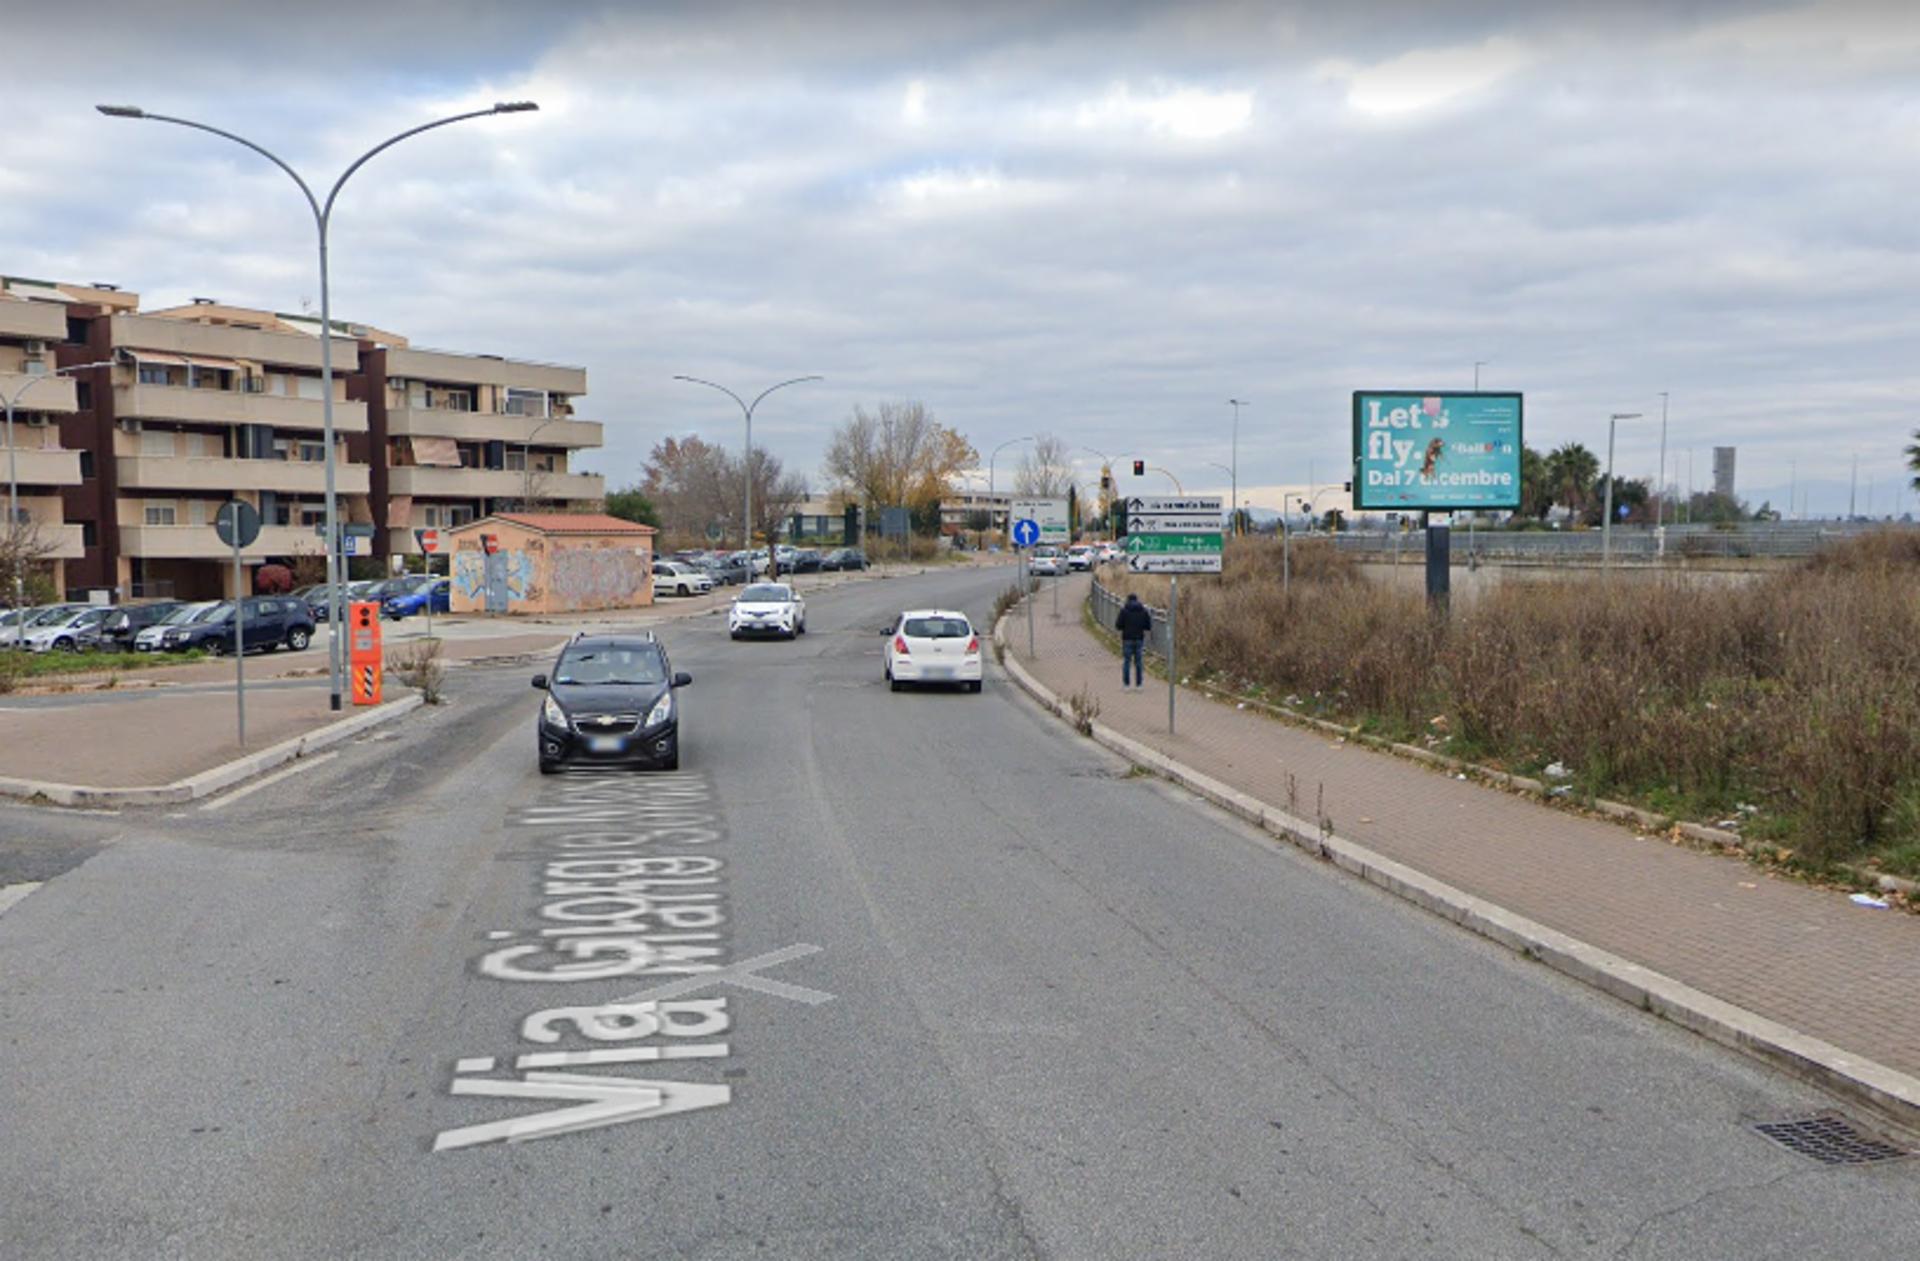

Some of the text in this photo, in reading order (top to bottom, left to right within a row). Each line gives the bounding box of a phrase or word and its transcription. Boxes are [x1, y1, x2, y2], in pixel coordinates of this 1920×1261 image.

[1368, 400, 1449, 429] Lets
[1368, 430, 1422, 468] fly.
[1368, 469, 1400, 486] Dal
[1404, 470, 1417, 486] 7
